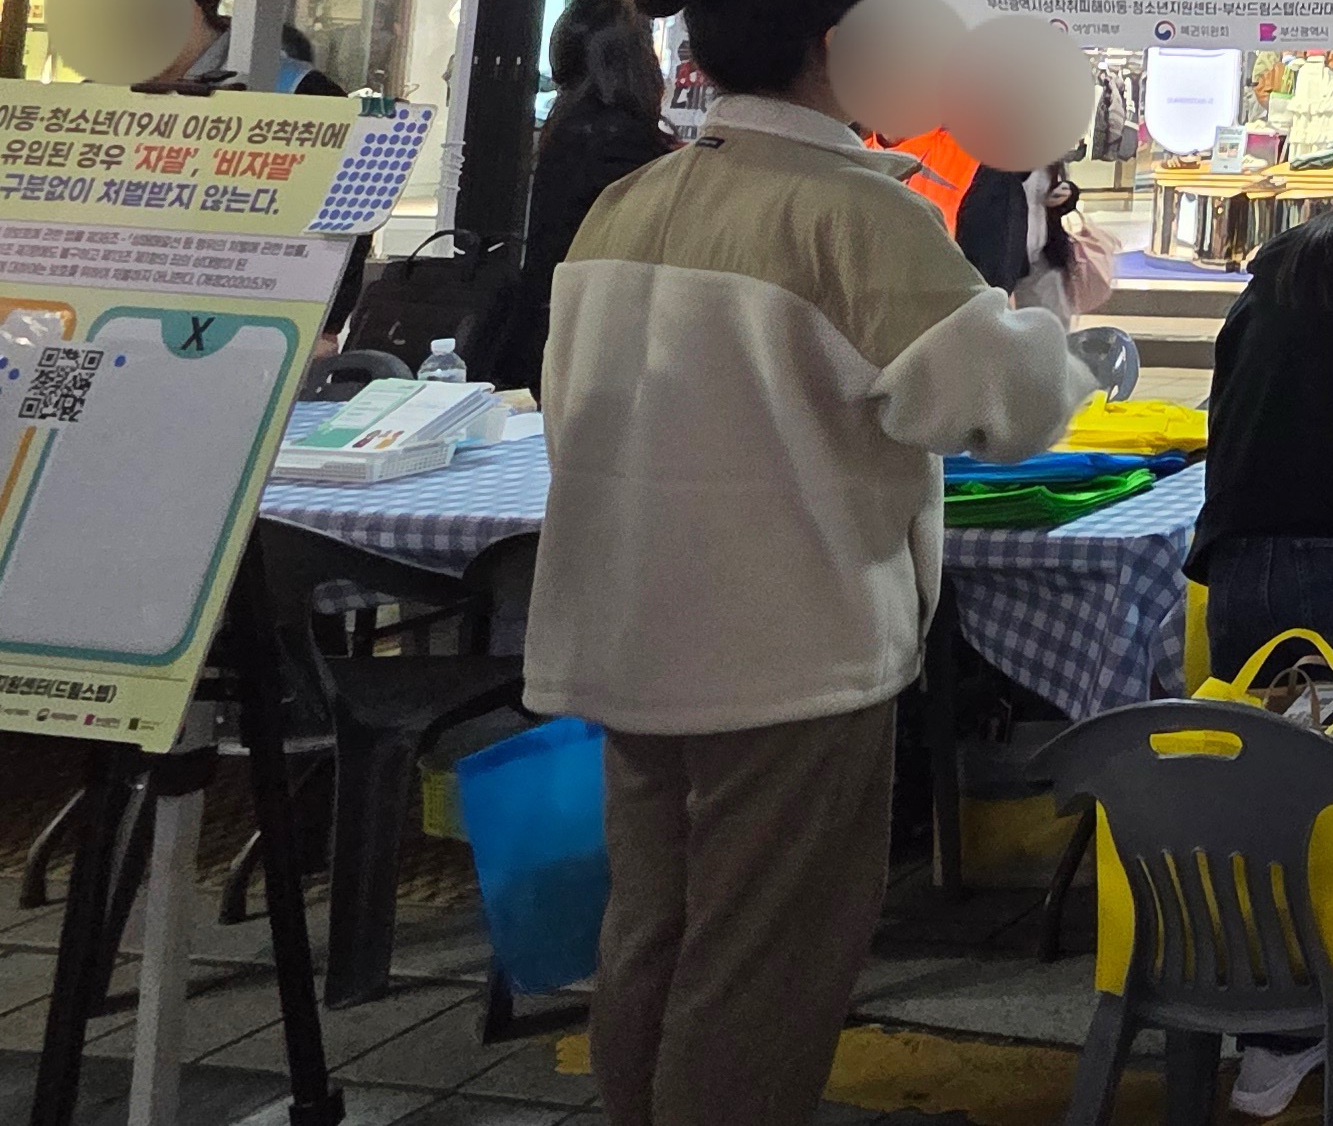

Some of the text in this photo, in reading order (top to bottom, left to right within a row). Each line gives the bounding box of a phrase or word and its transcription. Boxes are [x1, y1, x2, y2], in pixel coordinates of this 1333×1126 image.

[1280, 26, 1329, 37] 부산광역시
[182, 115, 243, 144] 이하)
[247, 119, 351, 149] 성착취에
[0, 139, 75, 167] 유입된
[77, 143, 126, 171] 경우
[0, 173, 280, 215] 구분없이 처벌받지 않는다.
